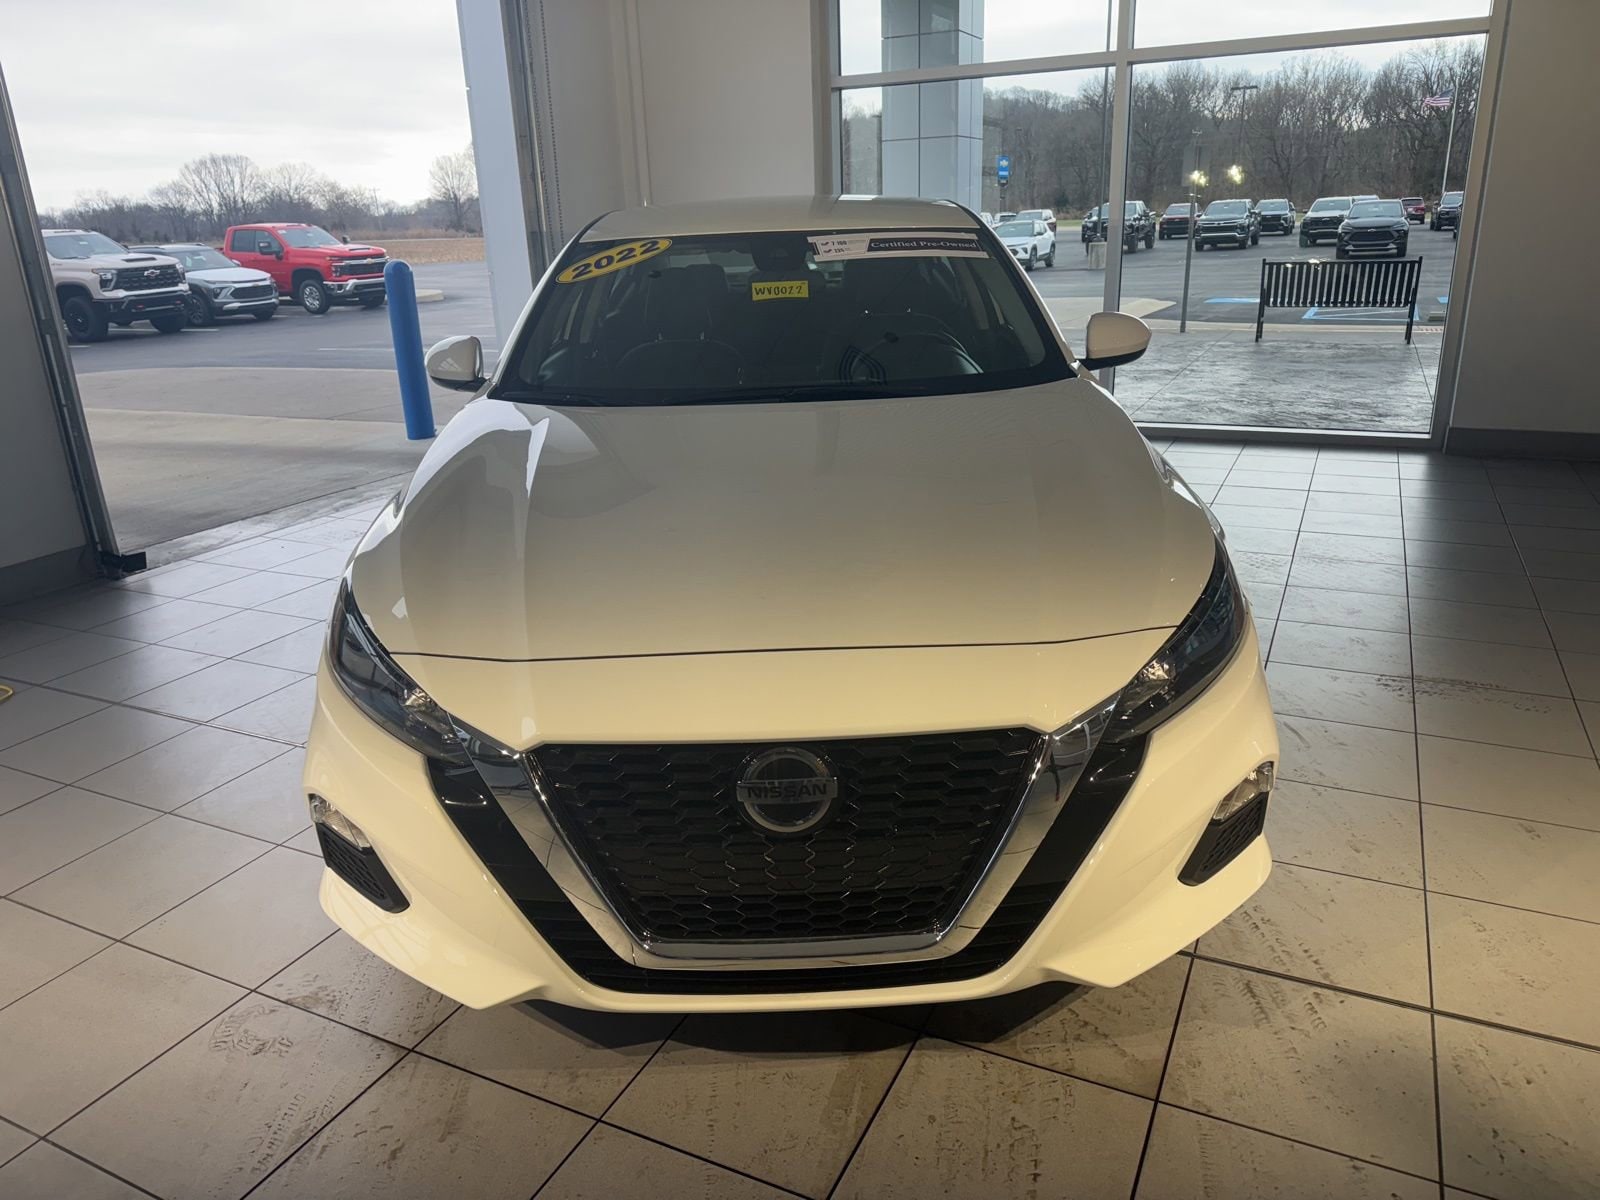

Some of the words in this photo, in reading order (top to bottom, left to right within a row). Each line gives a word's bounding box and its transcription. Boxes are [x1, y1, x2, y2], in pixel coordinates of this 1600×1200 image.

[870, 239, 918, 248] Certified
[919, 239, 977, 248] Pre-Owned
[572, 240, 661, 280] 2022
[747, 783, 827, 799] NISSAN
